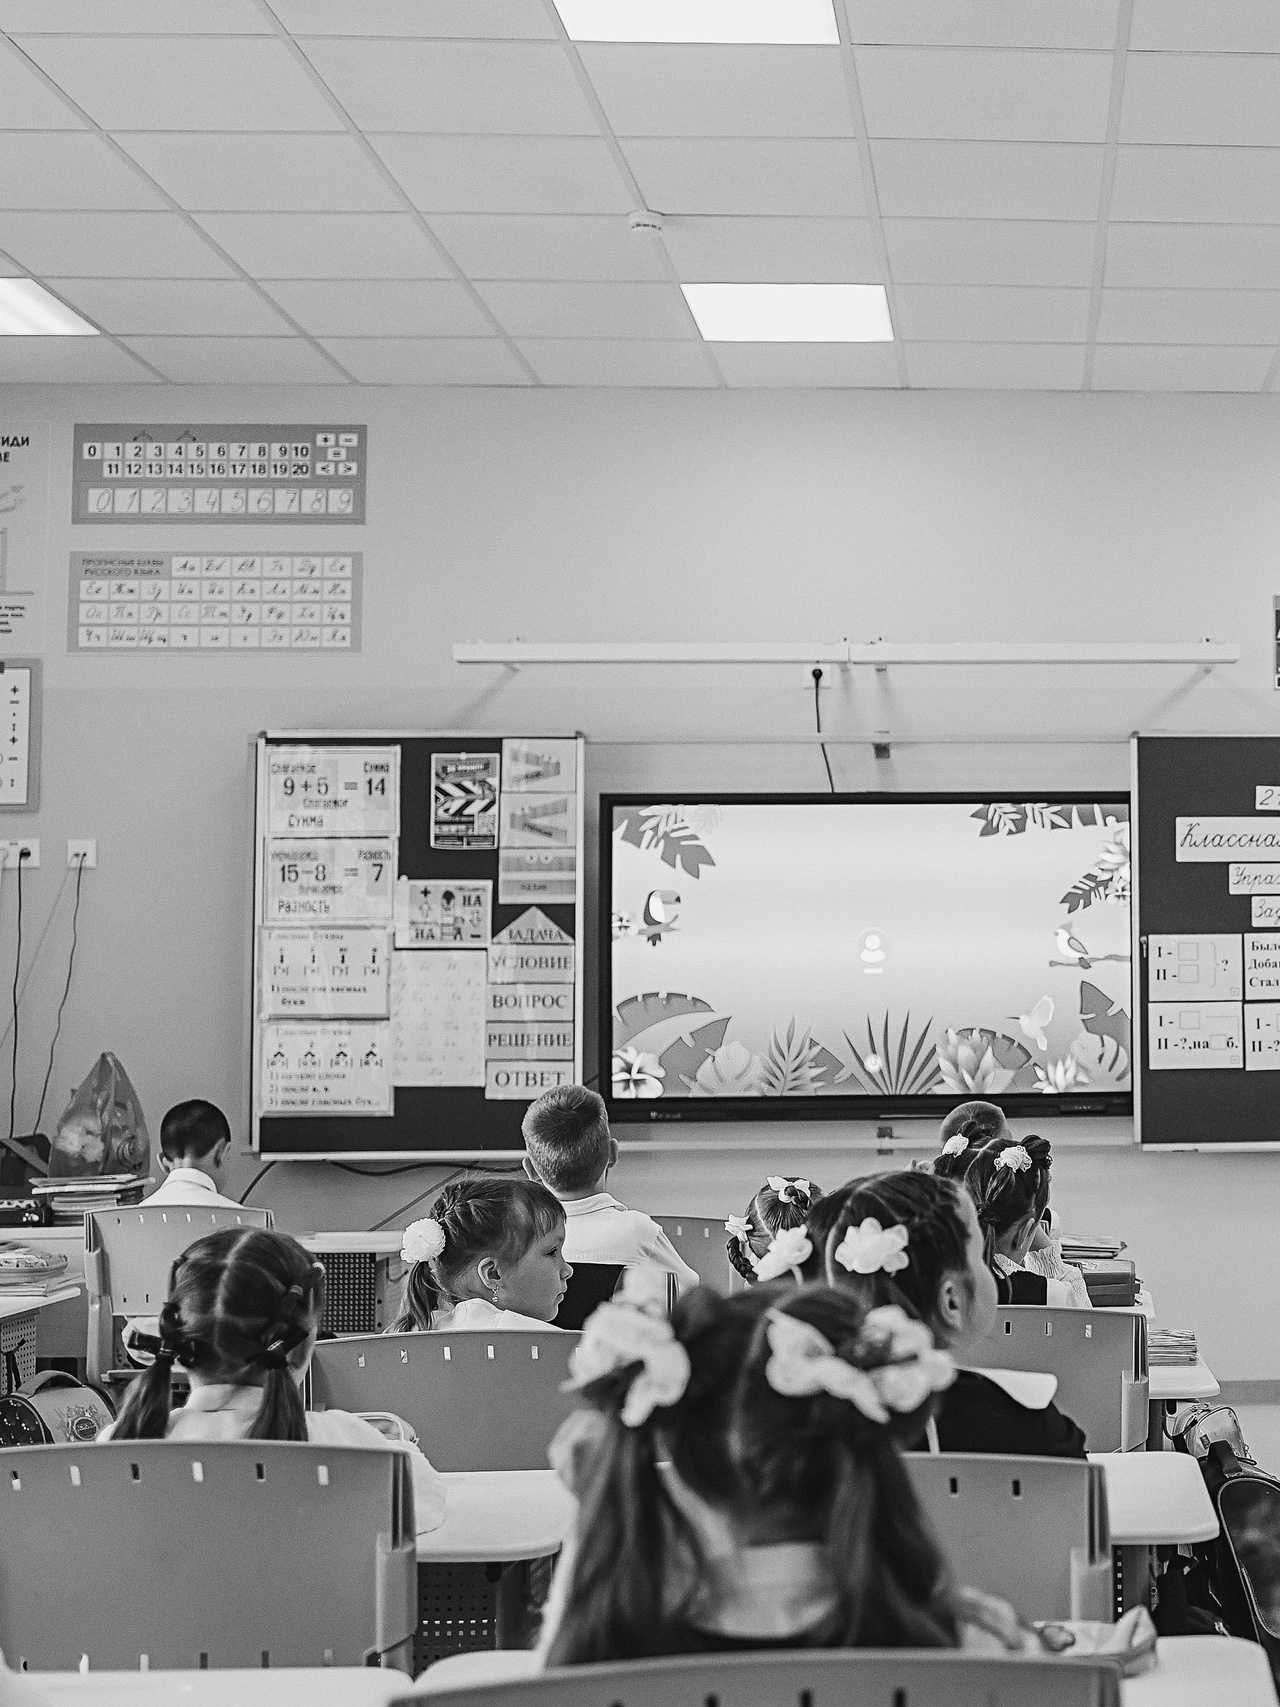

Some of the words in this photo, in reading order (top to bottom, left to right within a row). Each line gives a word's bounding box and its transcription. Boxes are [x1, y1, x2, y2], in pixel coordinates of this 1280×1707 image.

[0, 436, 30, 447] ИДИ
[88, 445, 96, 457] 0
[115, 445, 120, 457] 1
[134, 445, 142, 457] 2
[154, 445, 162, 457] 3
[175, 445, 182, 457] 4
[196, 445, 204, 457] 5
[217, 445, 226, 457] 6
[238, 445, 246, 457] 7
[258, 445, 266, 457] 8
[279, 445, 287, 457] 9
[294, 445, 309, 457] 10
[108, 463, 119, 475] 11
[127, 463, 142, 475] 12
[148, 463, 162, 475] 13
[168, 463, 183, 475] 14
[189, 463, 204, 475] 15
[210, 463, 226, 475] 16
[232, 463, 246, 475] 17
[252, 463, 266, 475] 18
[272, 463, 287, 475] 19
[293, 463, 309, 475] 20
[97, 488, 111, 512] 0
[127, 488, 139, 512] 1
[151, 488, 165, 512] 2
[178, 488, 193, 512] 3
[206, 488, 218, 512] 4
[231, 488, 245, 512] 5
[257, 488, 272, 512] 6
[286, 488, 298, 512] 7
[310, 488, 325, 512] 8
[337, 488, 352, 512] 9
[283, 777, 295, 796] 9
[317, 777, 328, 796] 5
[366, 777, 386, 796] 14
[372, 863, 384, 882] 7
[491, 955, 573, 969] УСЛОВИЕ
[493, 994, 568, 1010] ВОПРОС
[488, 1033, 573, 1048] РЕШЕНИЕ
[495, 1070, 566, 1088] ОТВЕТ
